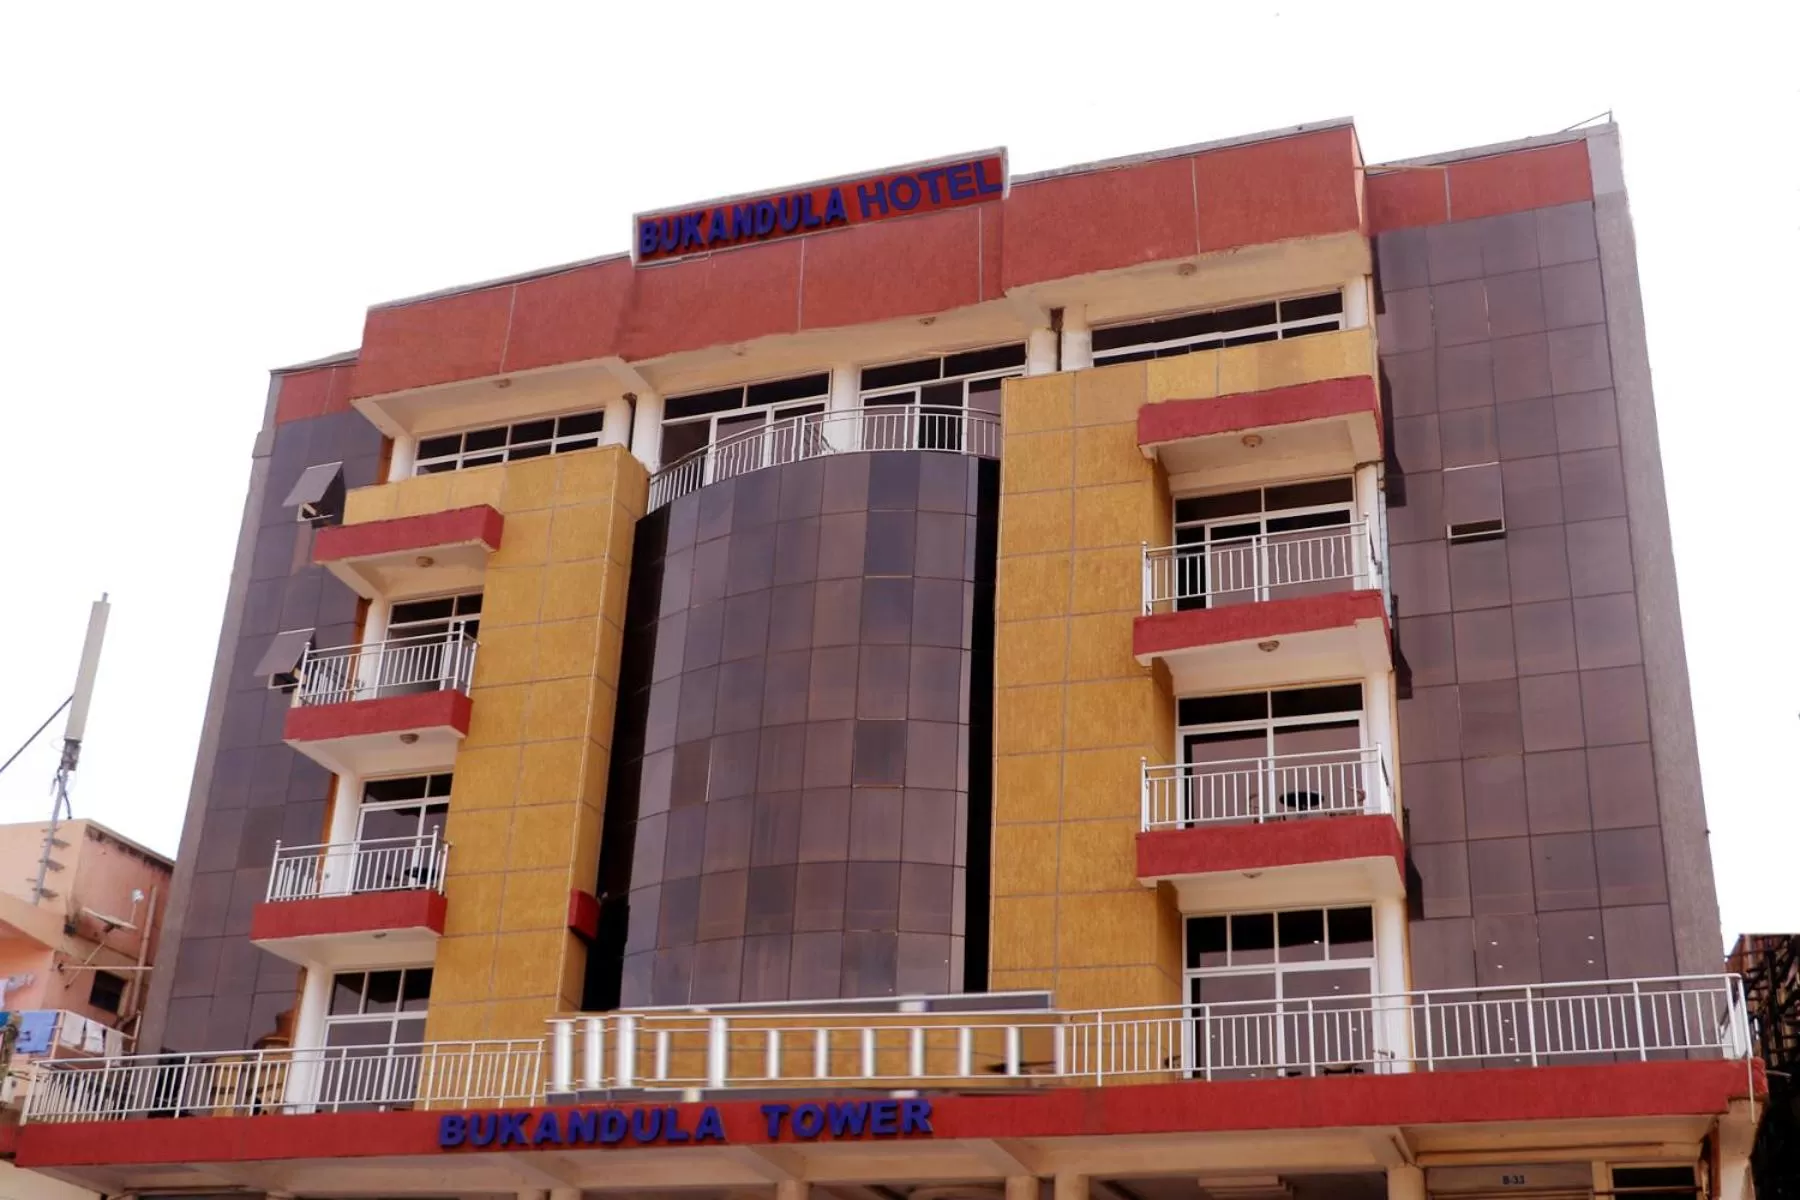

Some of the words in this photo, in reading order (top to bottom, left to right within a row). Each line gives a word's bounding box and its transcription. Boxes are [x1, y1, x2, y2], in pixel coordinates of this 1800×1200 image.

[640, 187, 847, 255] BUKANDULA
[857, 161, 1003, 218] HOTEL
[438, 1106, 725, 1147] BUKANDULA
[761, 1099, 933, 1138] TOWER
